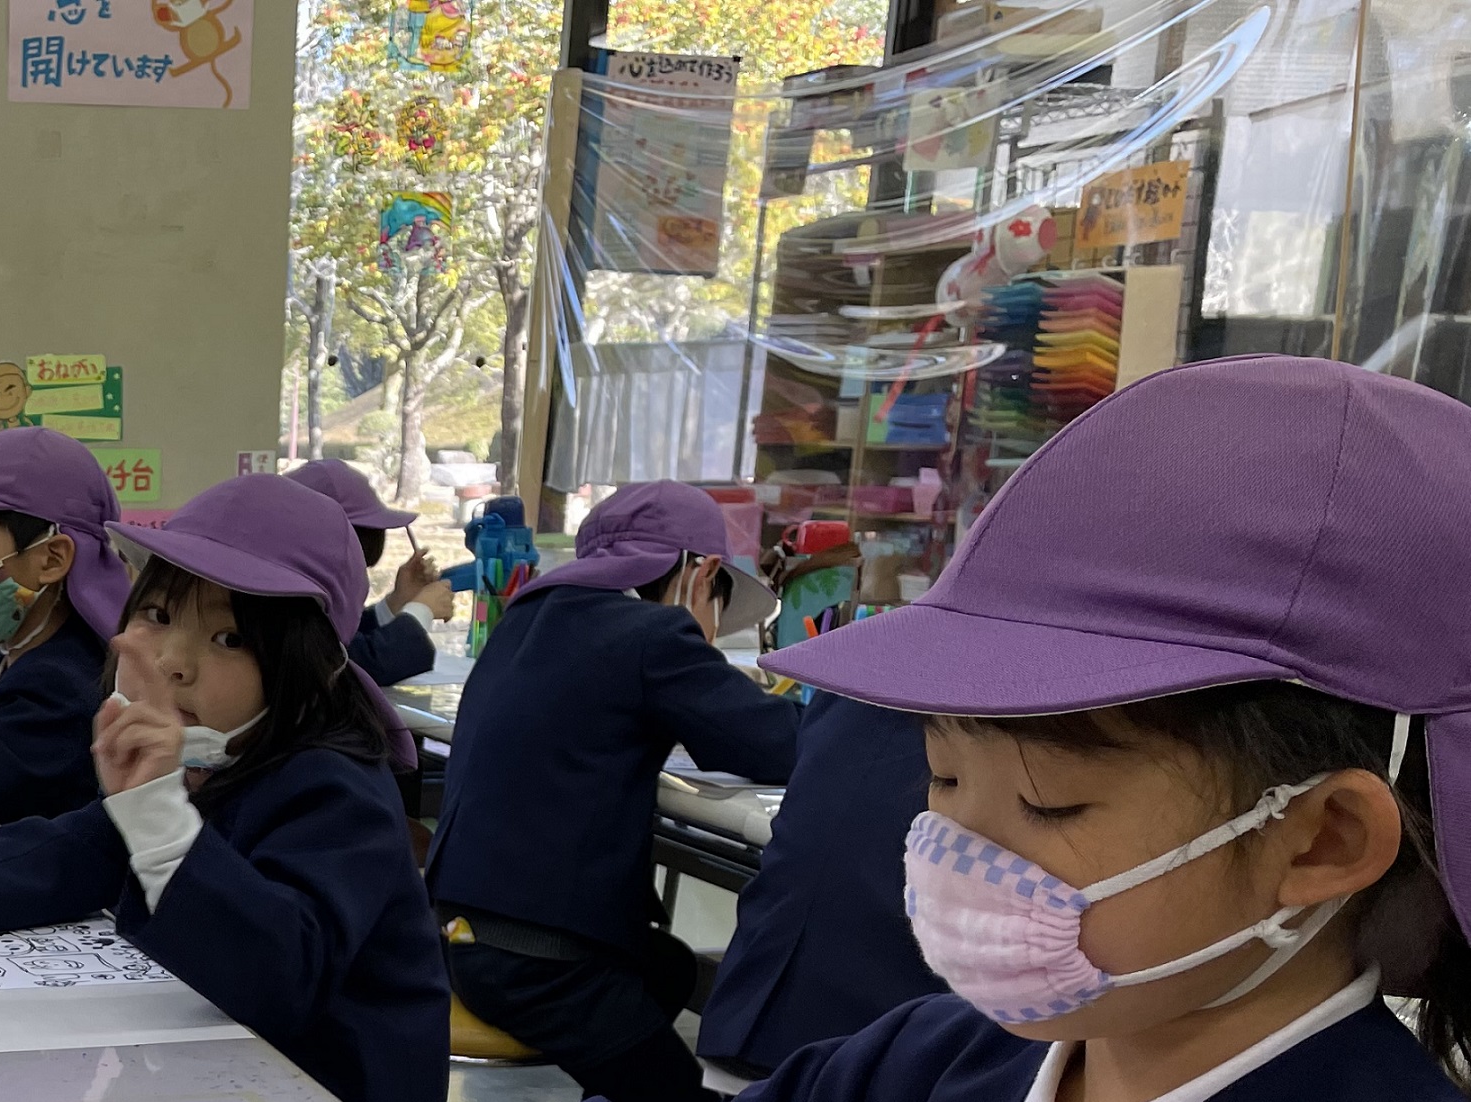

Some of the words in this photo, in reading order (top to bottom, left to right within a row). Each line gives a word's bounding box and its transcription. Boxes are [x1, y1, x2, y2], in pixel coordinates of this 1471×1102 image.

[22, 36, 173, 88] 開けています
[37, 358, 99, 381] おねがい
[107, 458, 154, 492] チ台
